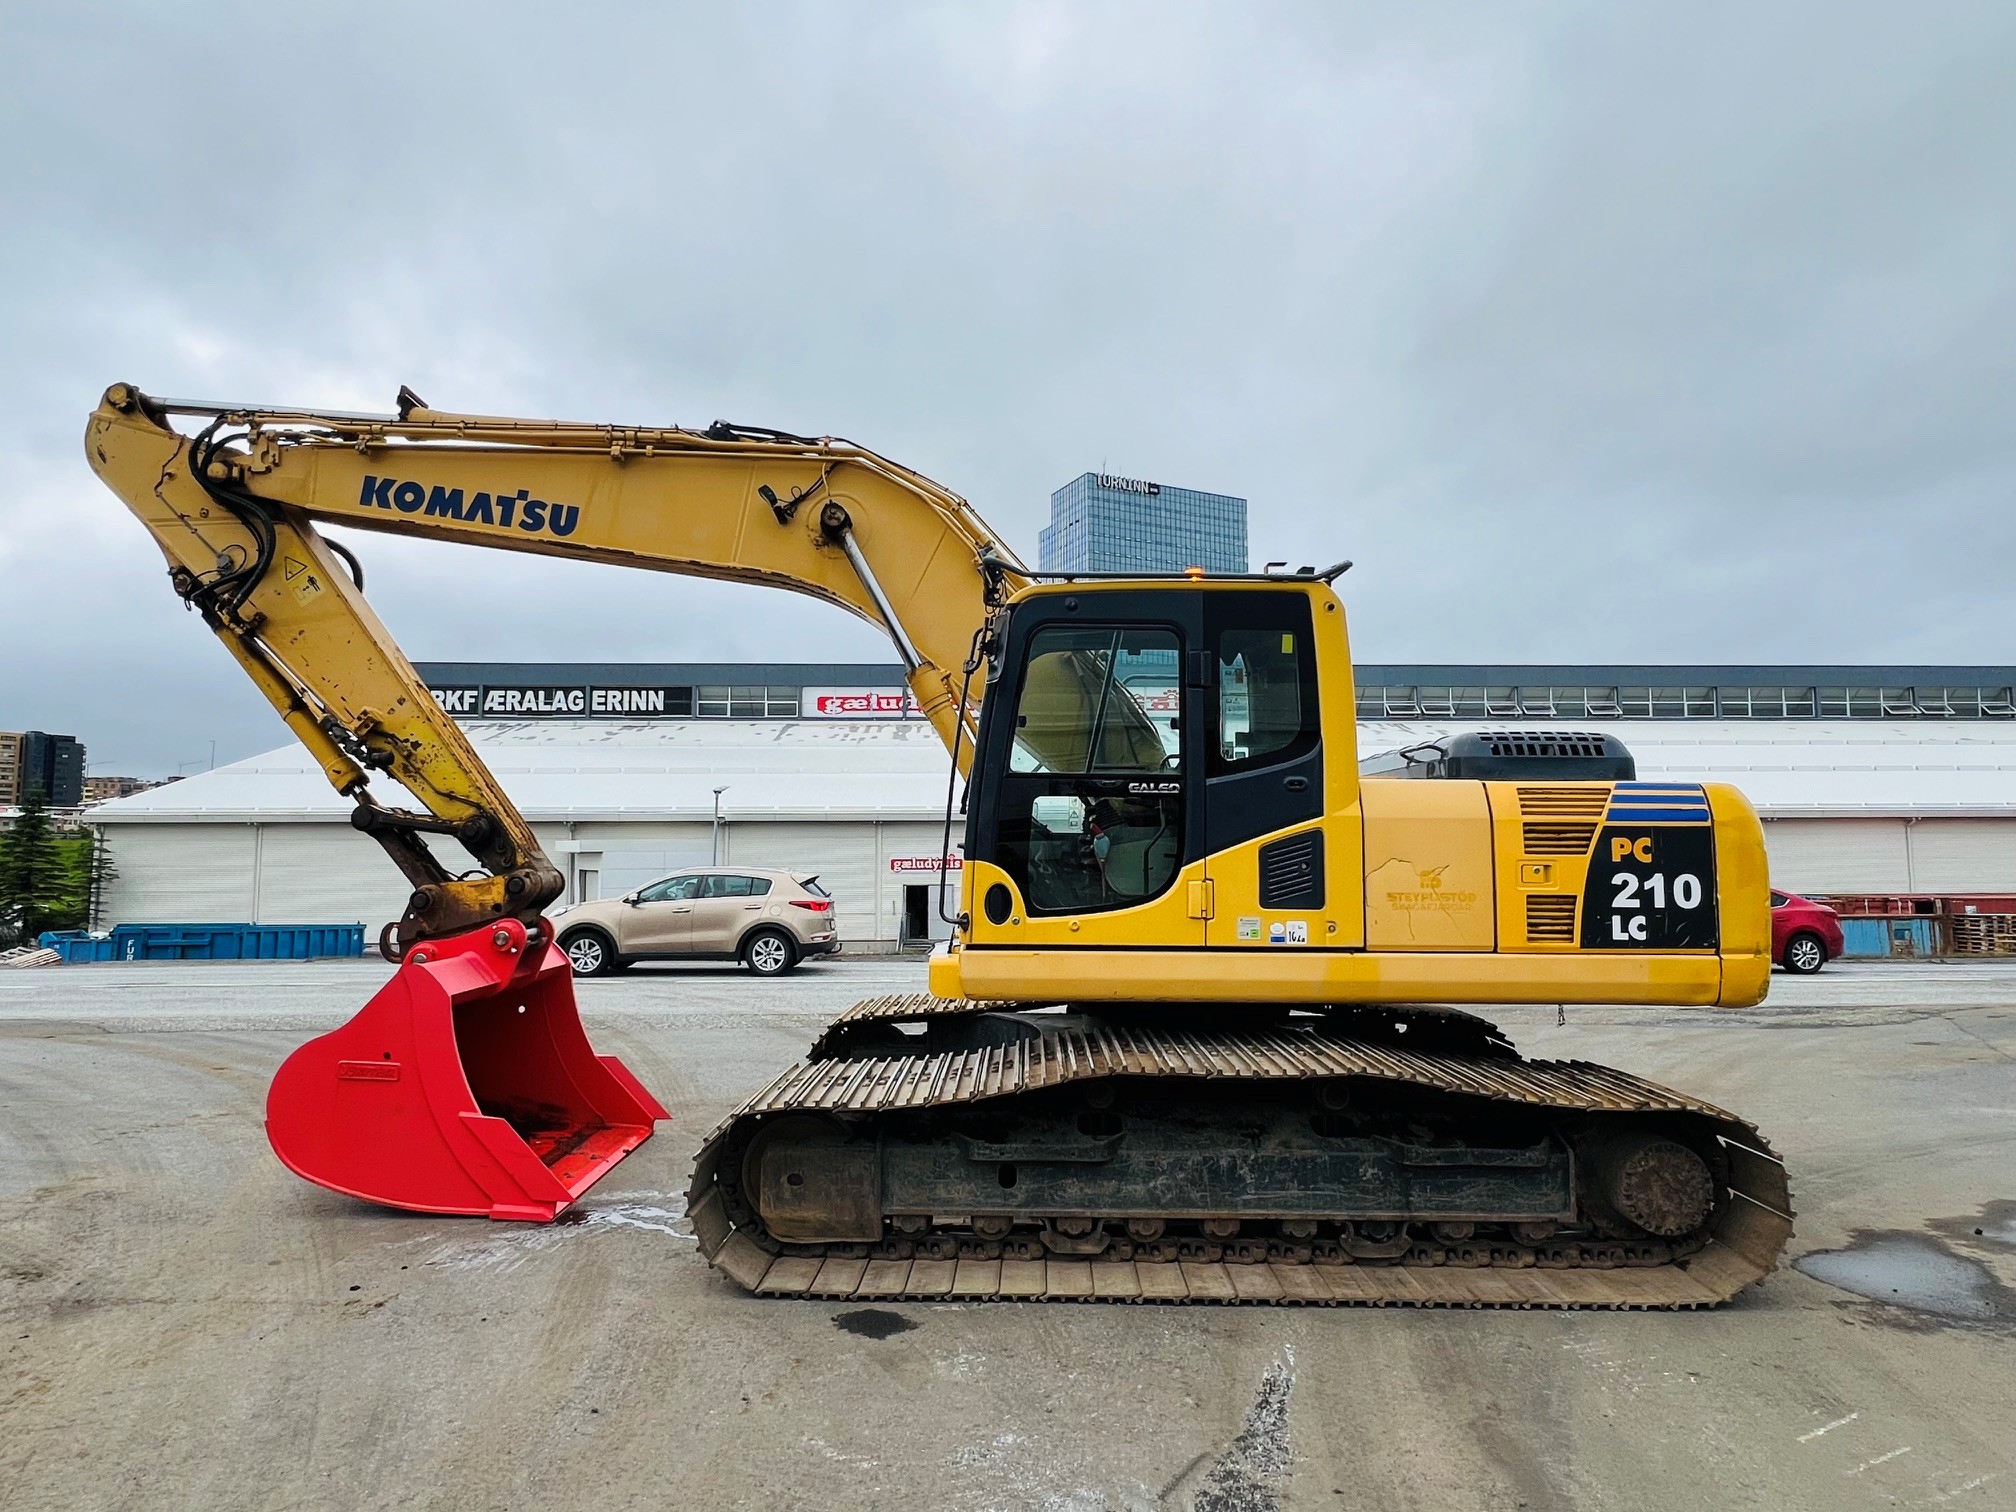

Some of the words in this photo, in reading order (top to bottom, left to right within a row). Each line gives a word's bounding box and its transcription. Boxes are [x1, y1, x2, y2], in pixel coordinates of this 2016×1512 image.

[359, 475, 580, 537] KOMATSU
[484, 690, 584, 711] ÆRALAG
[592, 690, 664, 711] ERINN
[824, 693, 921, 714] gælud
[1611, 837, 1653, 863] PC
[1611, 872, 1702, 909] 210
[1611, 915, 1647, 940] LC
